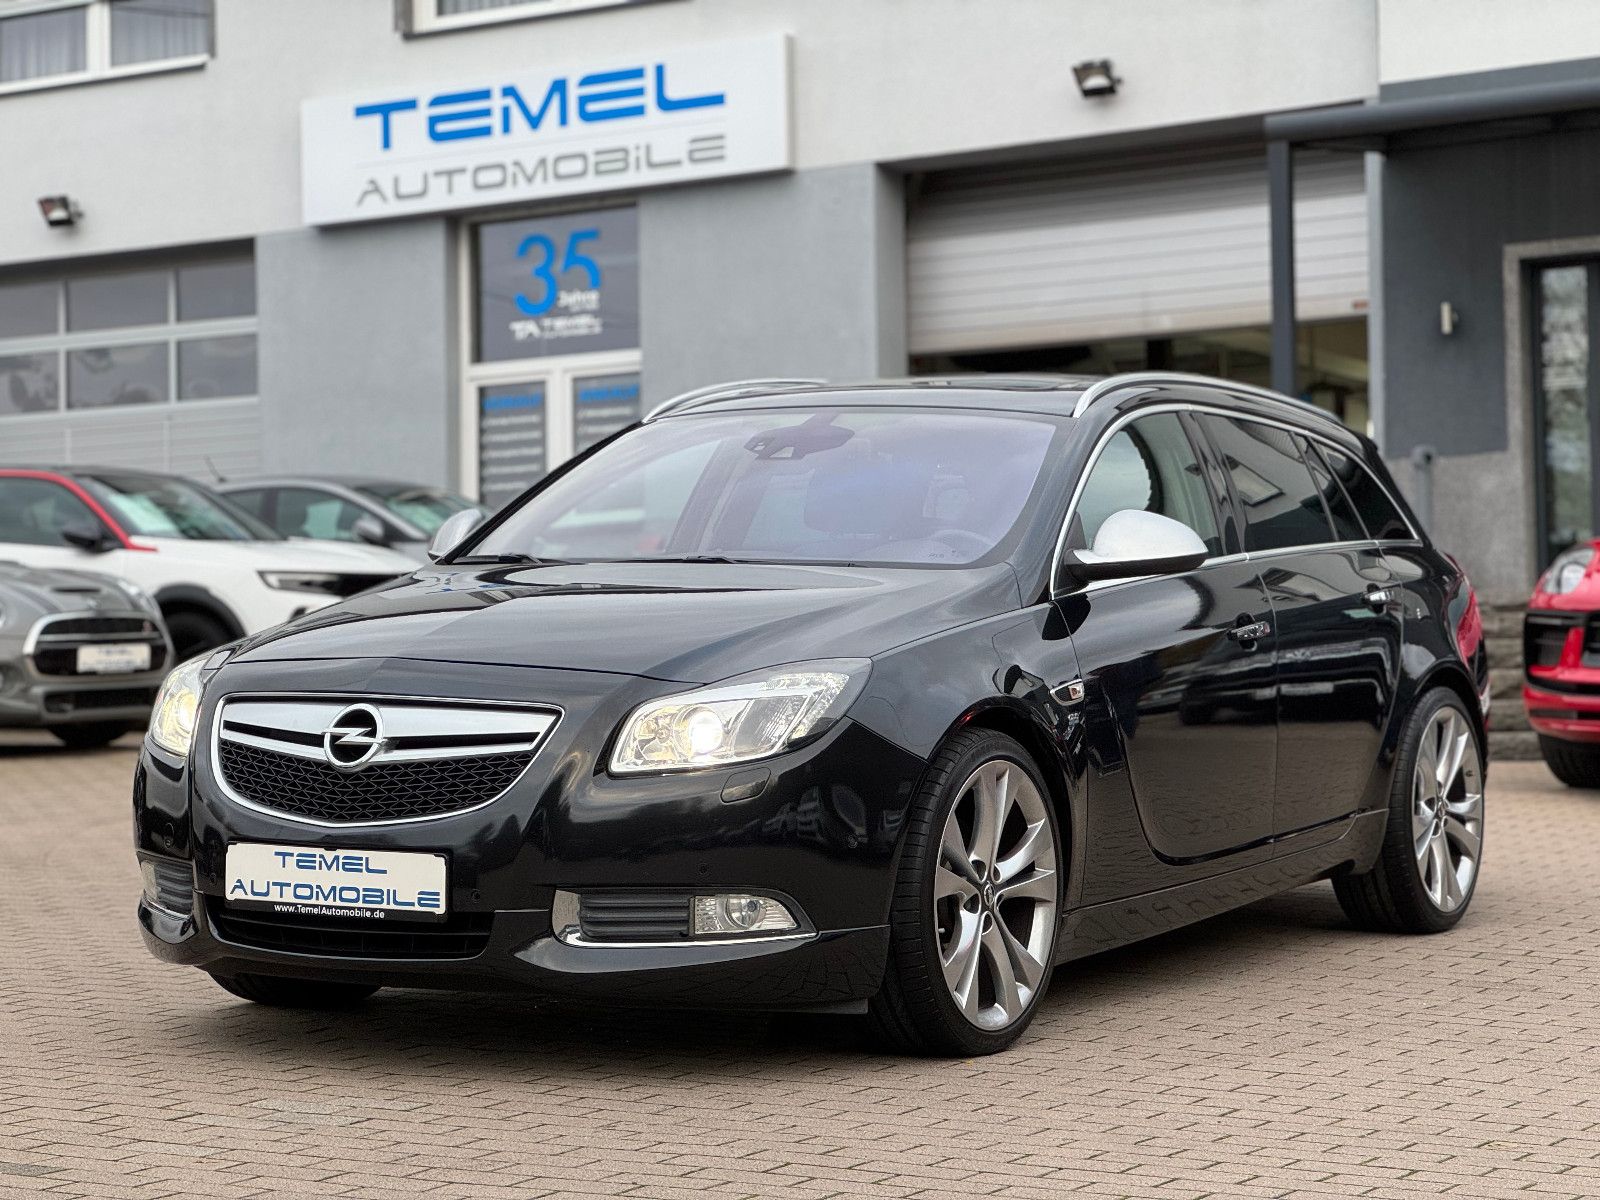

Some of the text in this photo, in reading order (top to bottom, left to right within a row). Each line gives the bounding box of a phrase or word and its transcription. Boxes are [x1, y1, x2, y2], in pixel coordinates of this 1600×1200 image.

[354, 63, 726, 151] TEMEL
[513, 228, 602, 317] 35
[274, 851, 388, 875] TEMEL
[229, 878, 441, 909] AUTOMOBILE
[274, 904, 385, 919] www.TemelAutomobile.de
